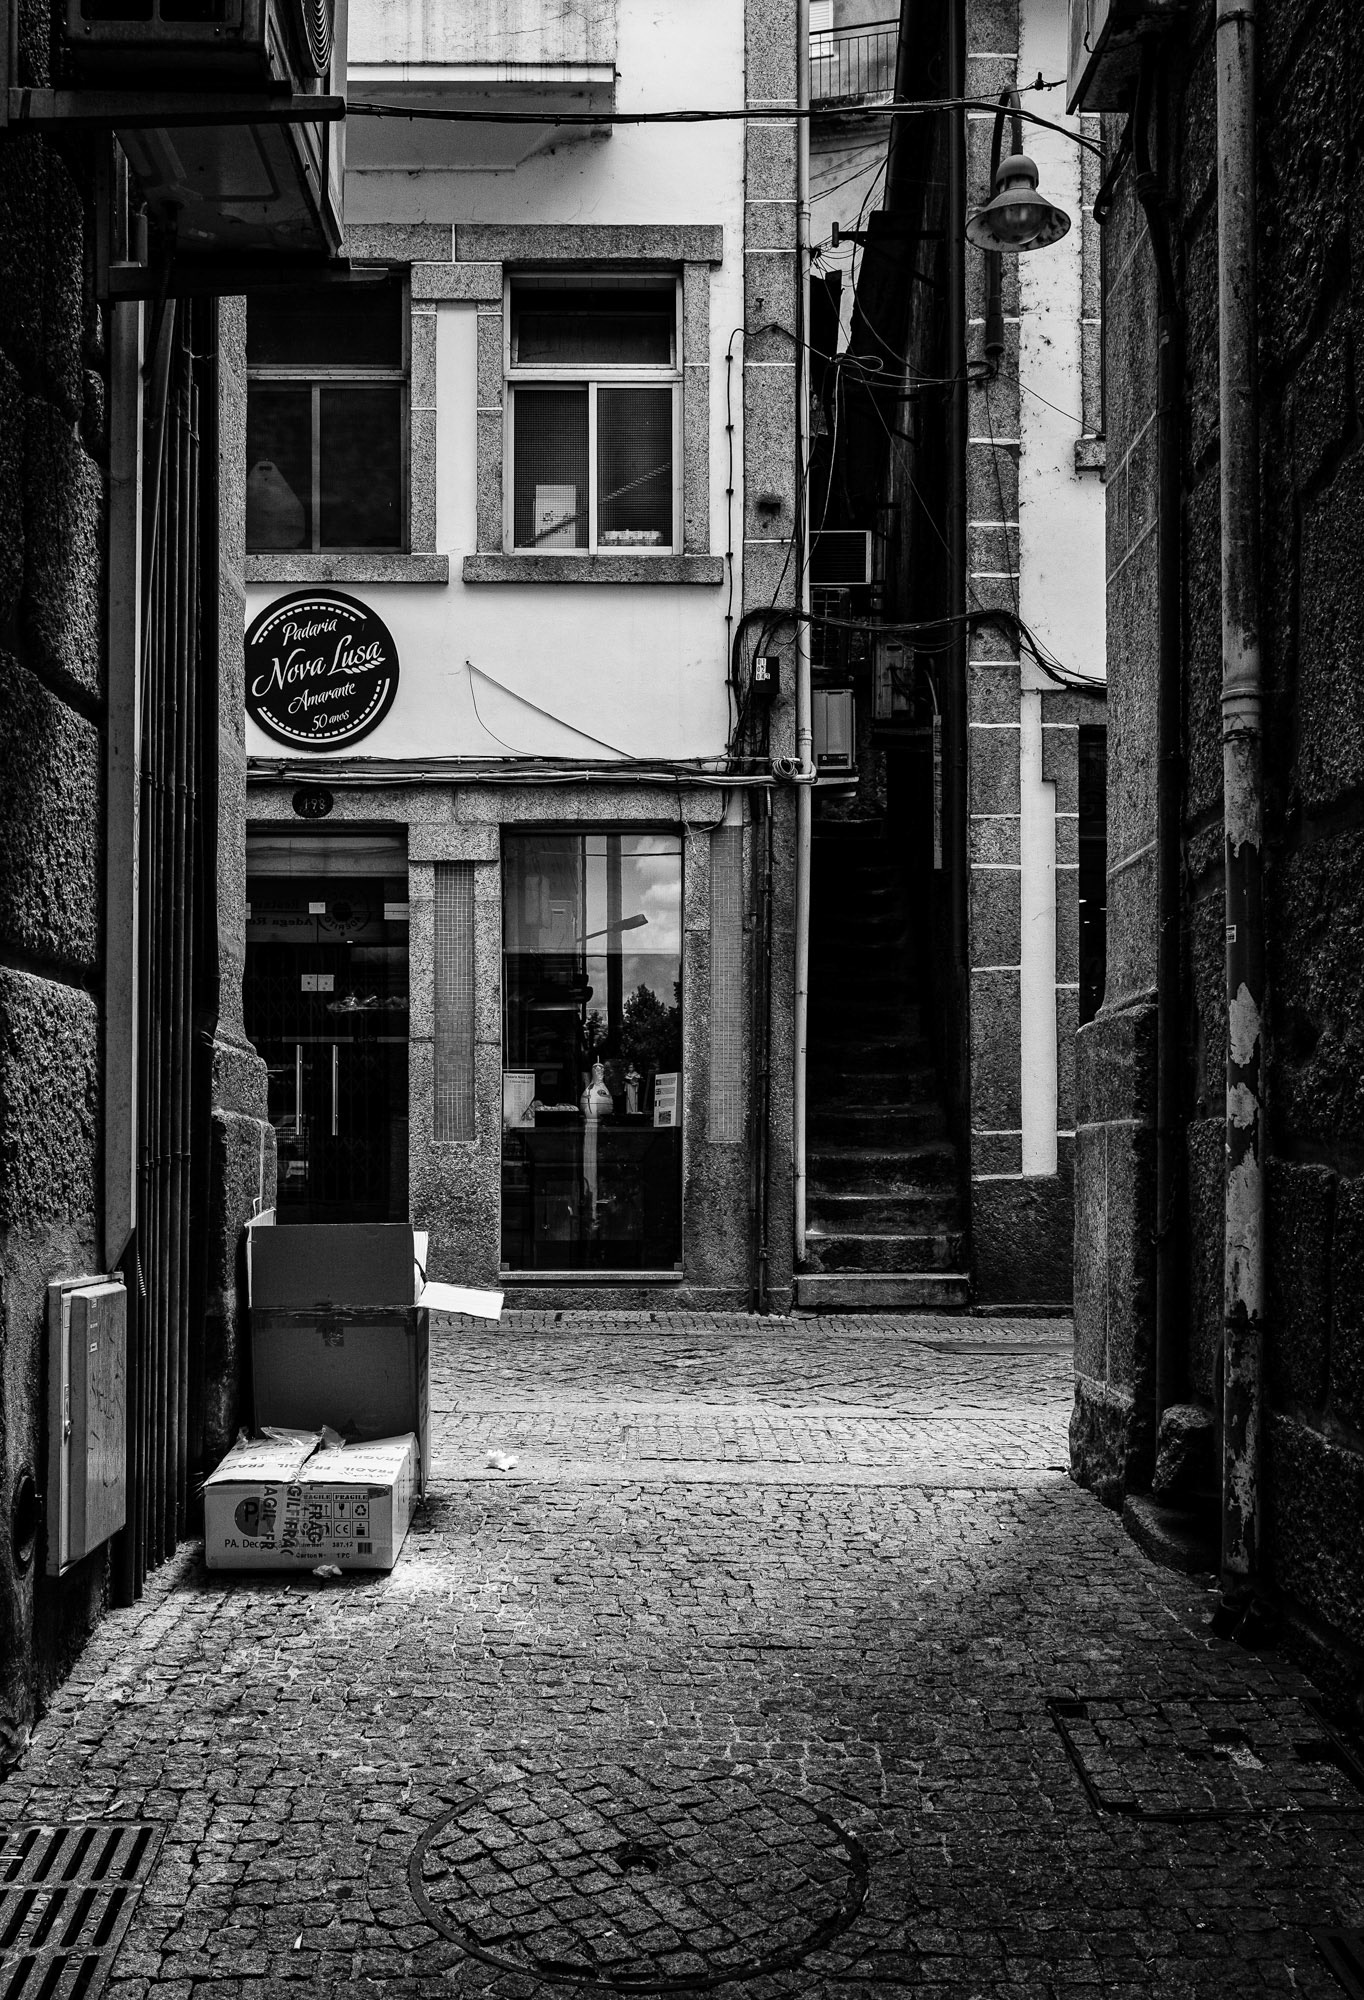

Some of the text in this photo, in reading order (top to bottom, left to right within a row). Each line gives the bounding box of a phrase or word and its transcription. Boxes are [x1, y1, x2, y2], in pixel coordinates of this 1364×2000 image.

[282, 618, 338, 646] Padaria
[251, 634, 383, 697] Nova Lusa
[287, 681, 357, 714] Amarante
[311, 709, 350, 731] 50 anos
[224, 1538, 240, 1548] PA.
